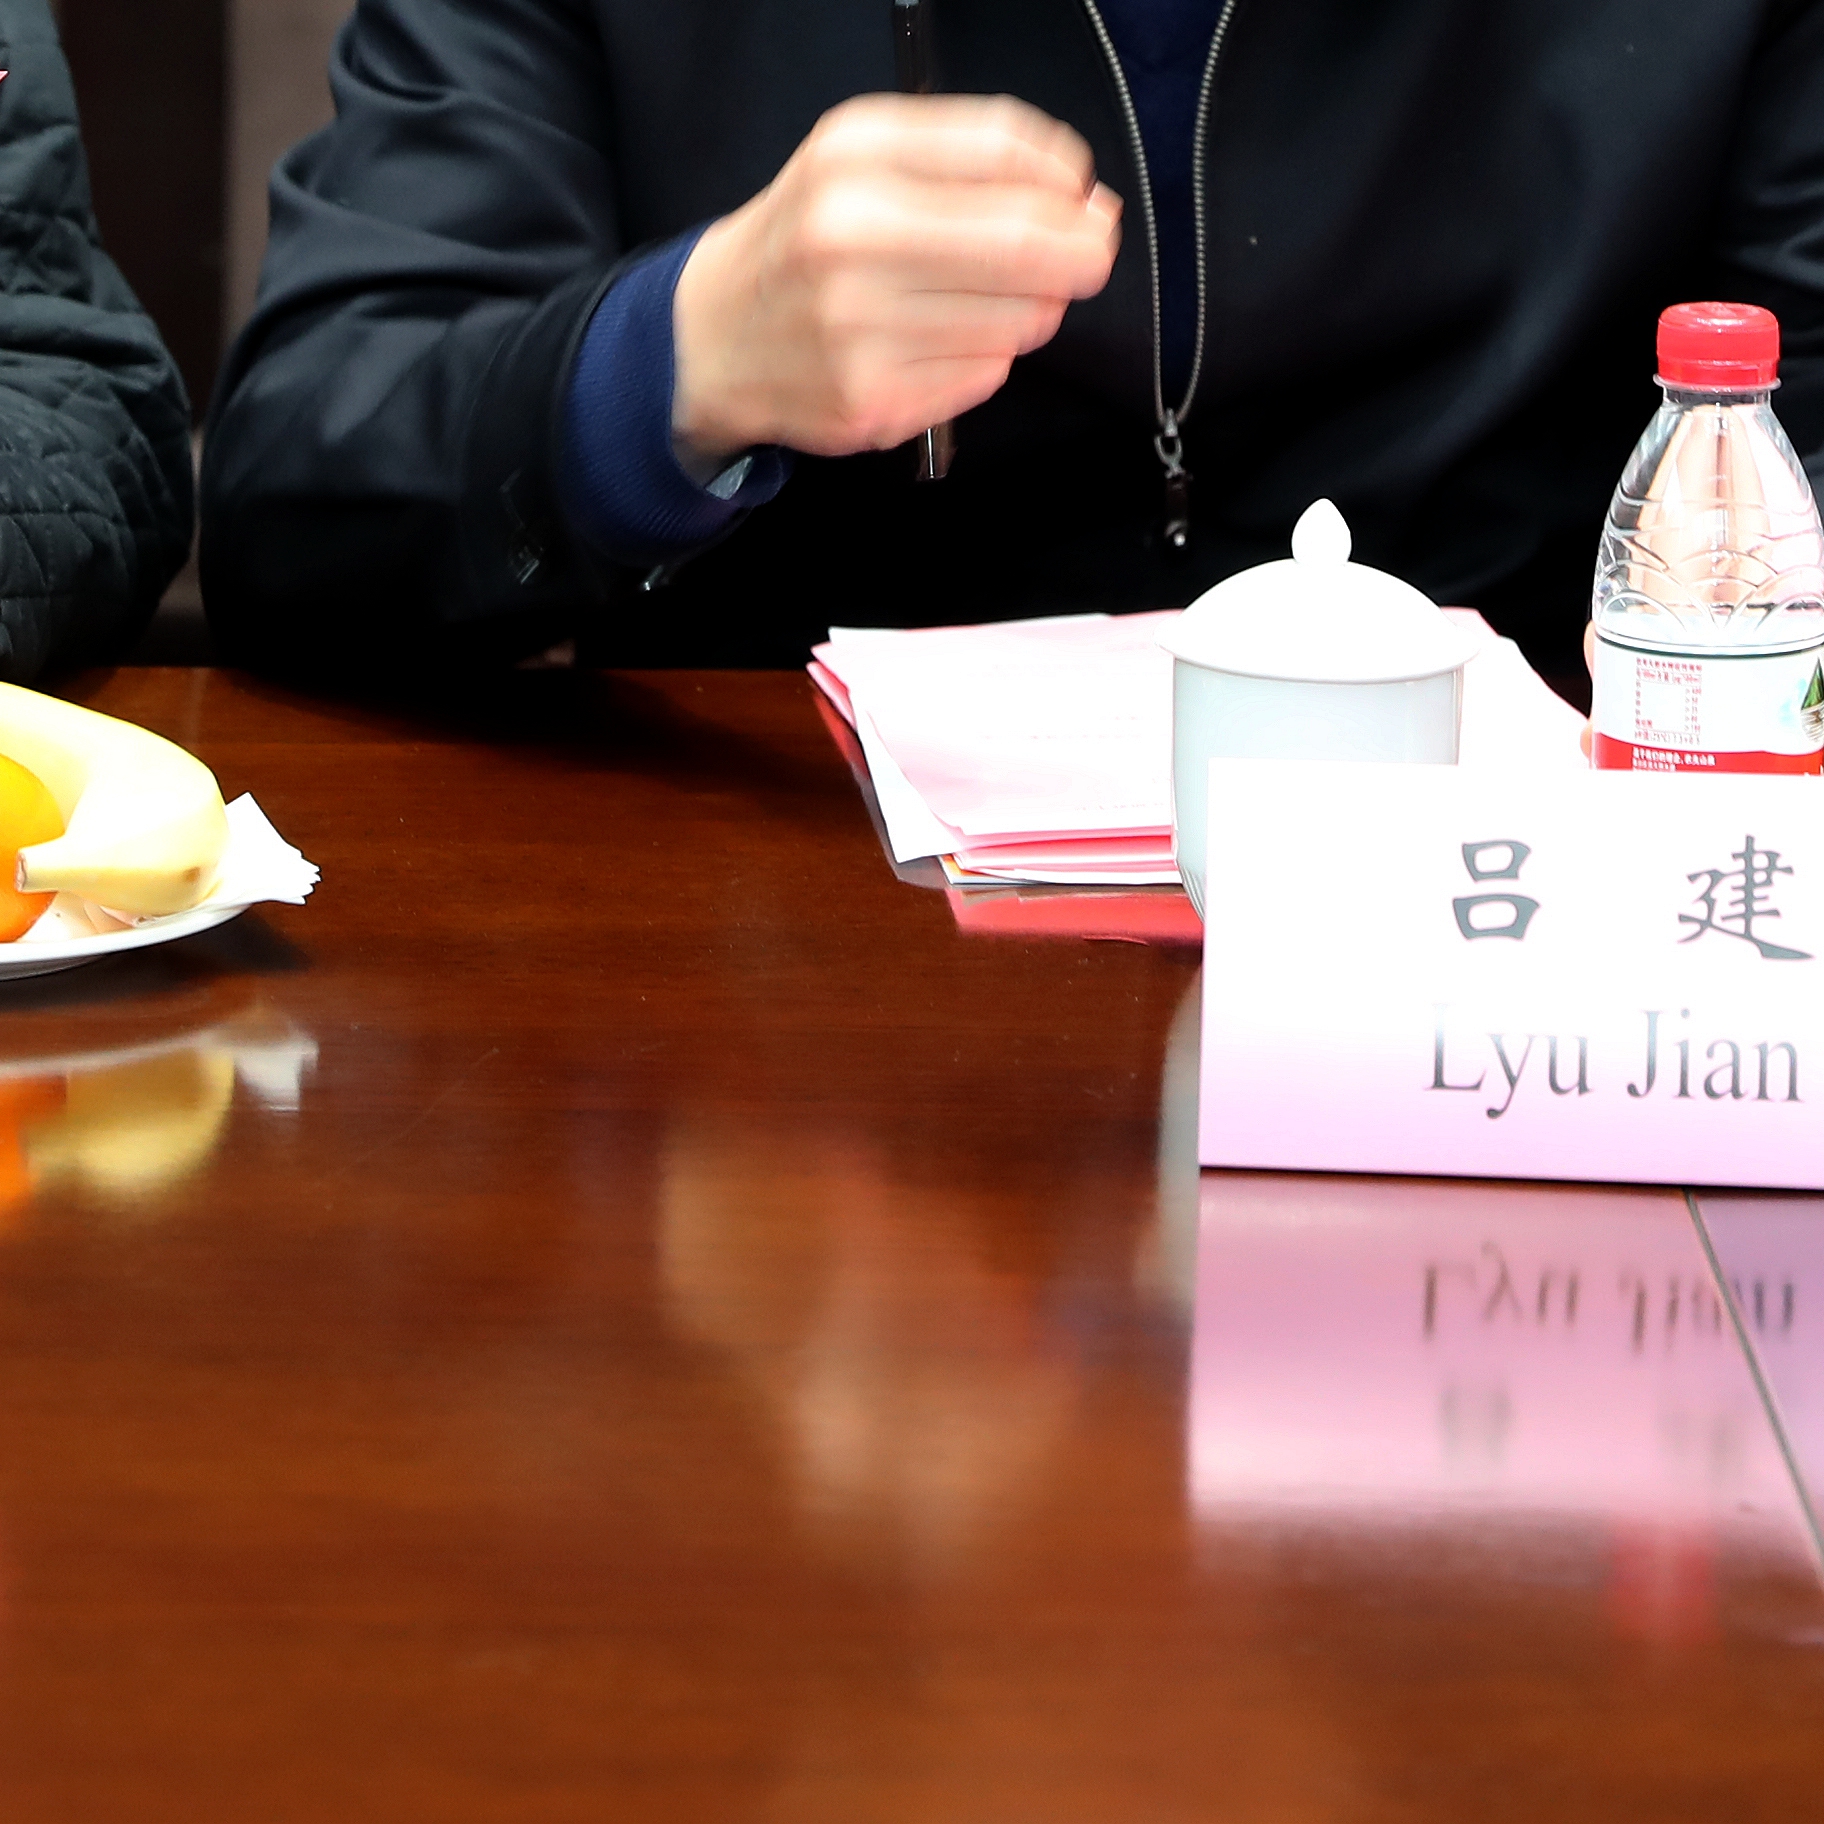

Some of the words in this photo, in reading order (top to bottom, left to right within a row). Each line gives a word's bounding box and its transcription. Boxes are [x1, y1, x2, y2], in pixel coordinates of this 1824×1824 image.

[1451, 839, 1541, 943] 吕
[1676, 834, 1816, 962] 建
[1423, 1011, 1594, 1122] Lyu
[1624, 1008, 1805, 1104] Jian
